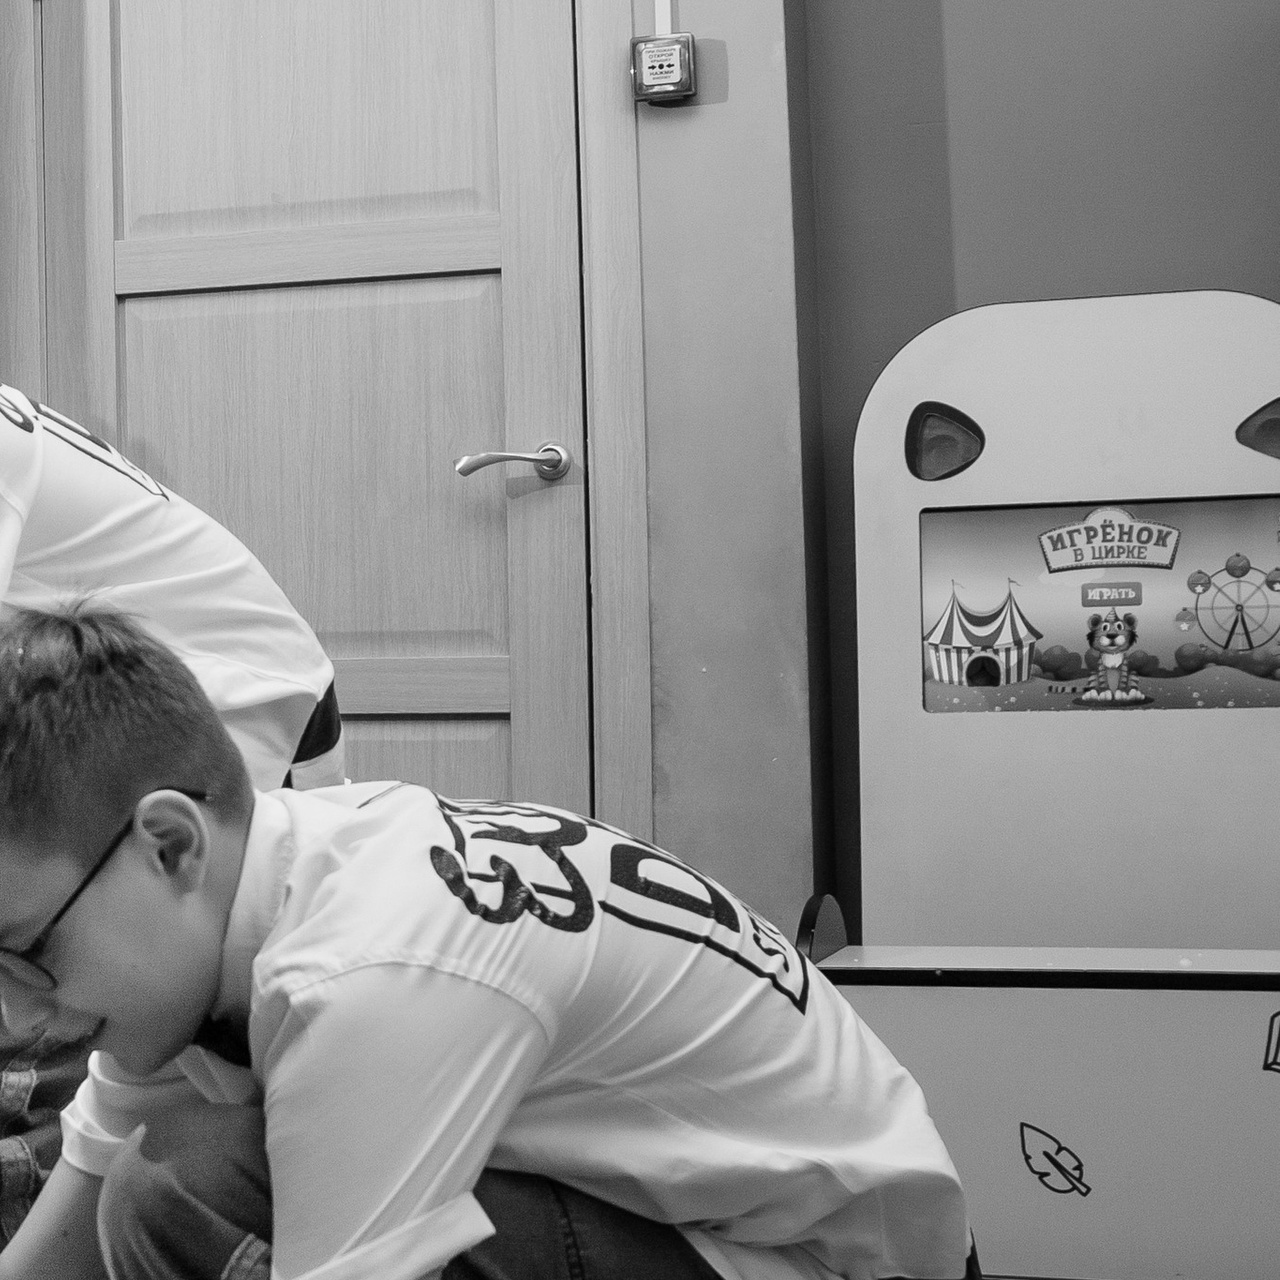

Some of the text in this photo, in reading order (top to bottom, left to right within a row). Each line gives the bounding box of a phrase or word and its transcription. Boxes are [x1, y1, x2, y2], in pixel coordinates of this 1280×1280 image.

[1047, 519, 1173, 552] ИГРЁНОК
[1073, 545, 1148, 563] В ЦИРКЕ
[1087, 588, 1136, 601] ИГРАТЬ
